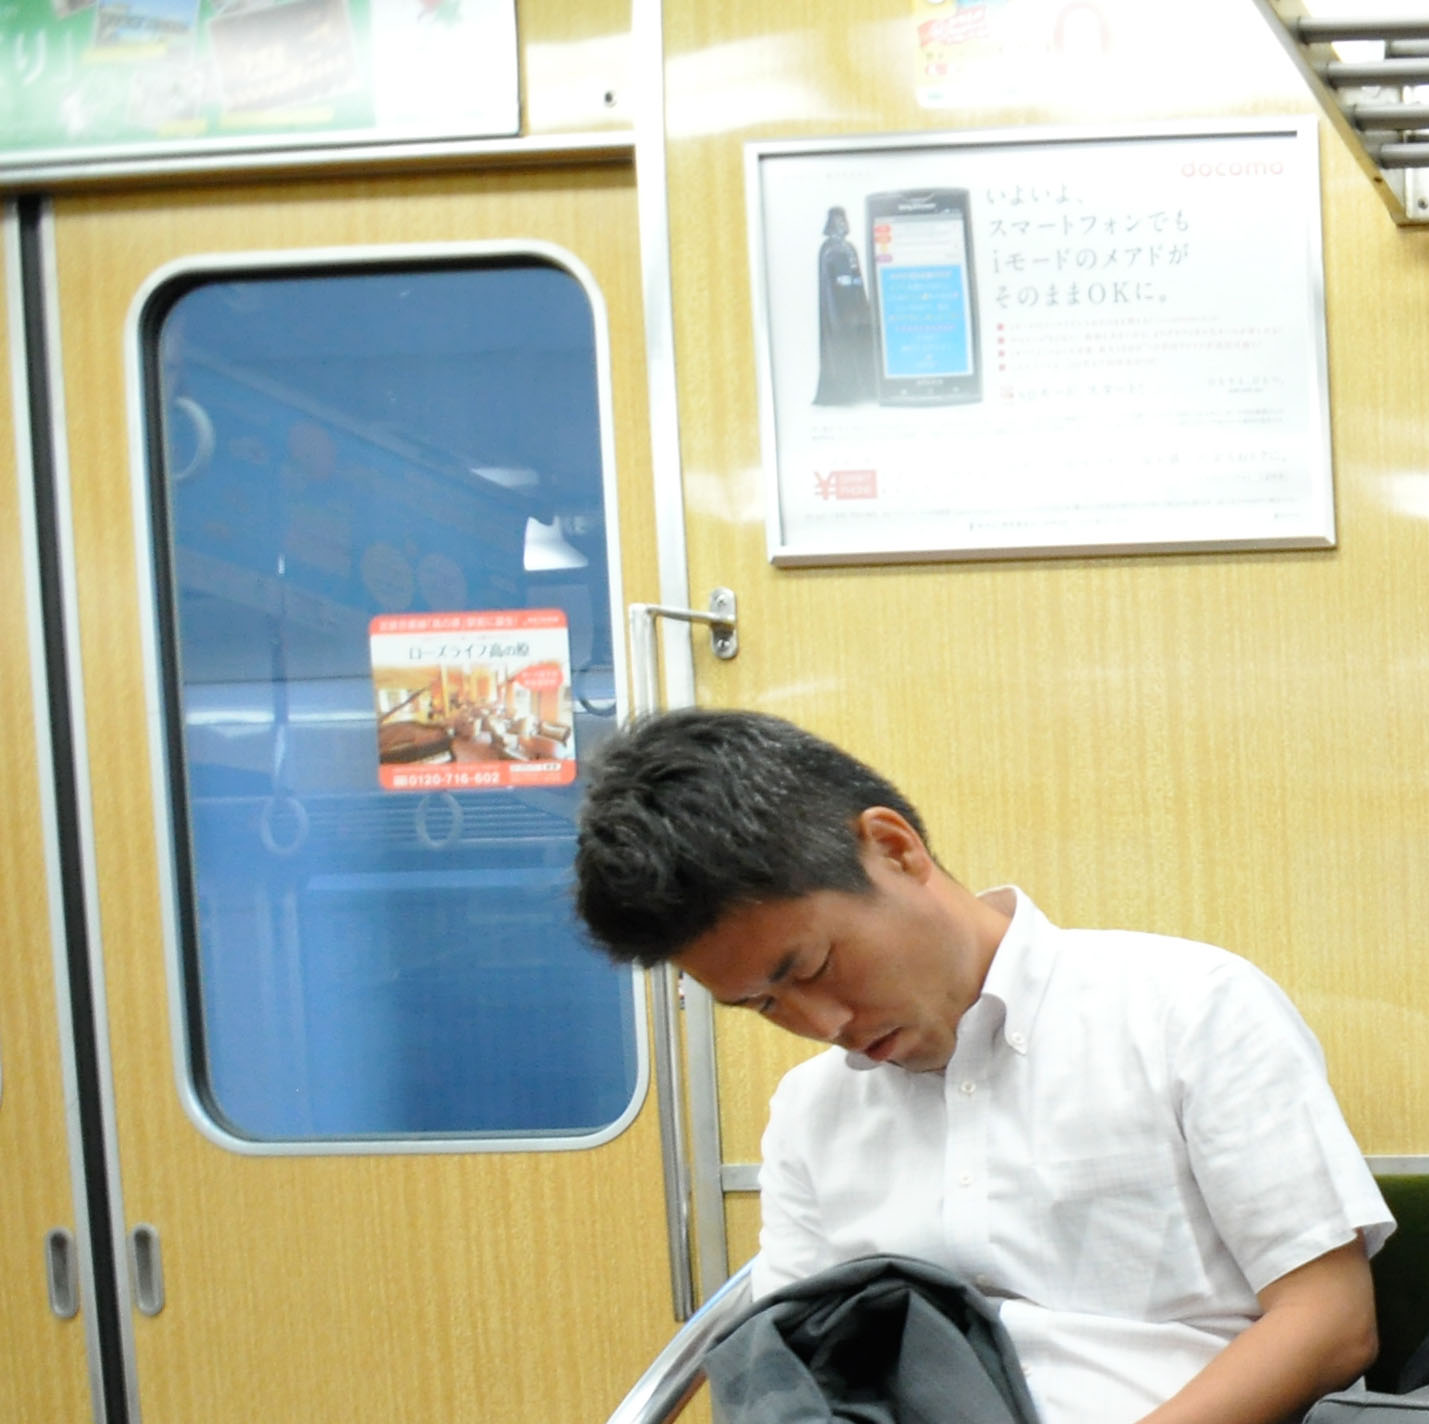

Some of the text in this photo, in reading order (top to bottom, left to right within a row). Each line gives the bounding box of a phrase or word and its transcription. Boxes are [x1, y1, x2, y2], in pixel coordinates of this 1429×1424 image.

[1181, 159, 1284, 178] docomo
[987, 183, 1085, 206] いよいよ、
[989, 209, 1190, 238] スマートフォンでも
[994, 280, 1169, 310] そのままOKに。
[408, 772, 500, 787] 0120-716-602
